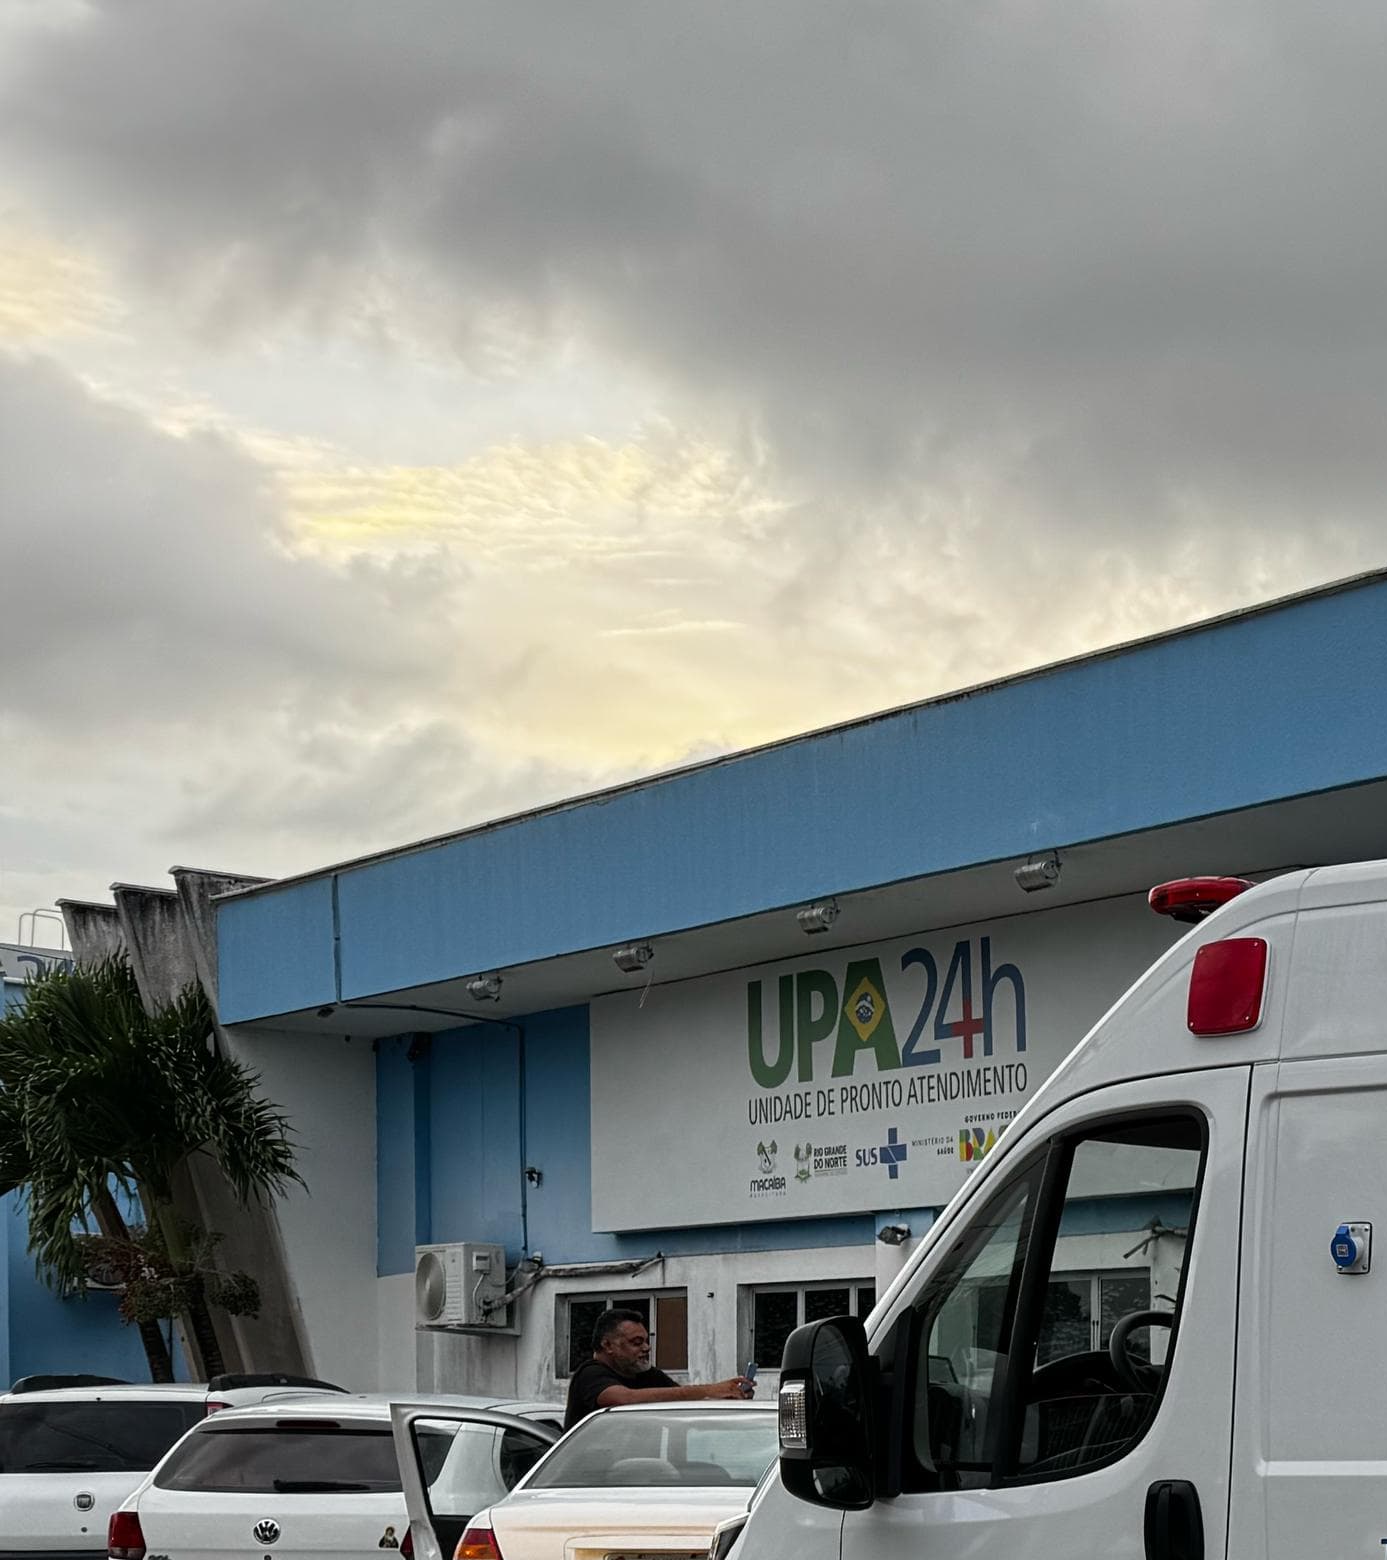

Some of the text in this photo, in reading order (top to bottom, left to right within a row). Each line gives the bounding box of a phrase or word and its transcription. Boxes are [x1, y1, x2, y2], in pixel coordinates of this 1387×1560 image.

[749, 1063, 1027, 1125] UNIDADE DE PRONTO ATENDIMENTO
[965, 1110, 1018, 1123] GOVERNO FEDER
[824, 1145, 847, 1157] GRANDE
[855, 1147, 878, 1167] SUS
[814, 1156, 847, 1169] DO NORTE
